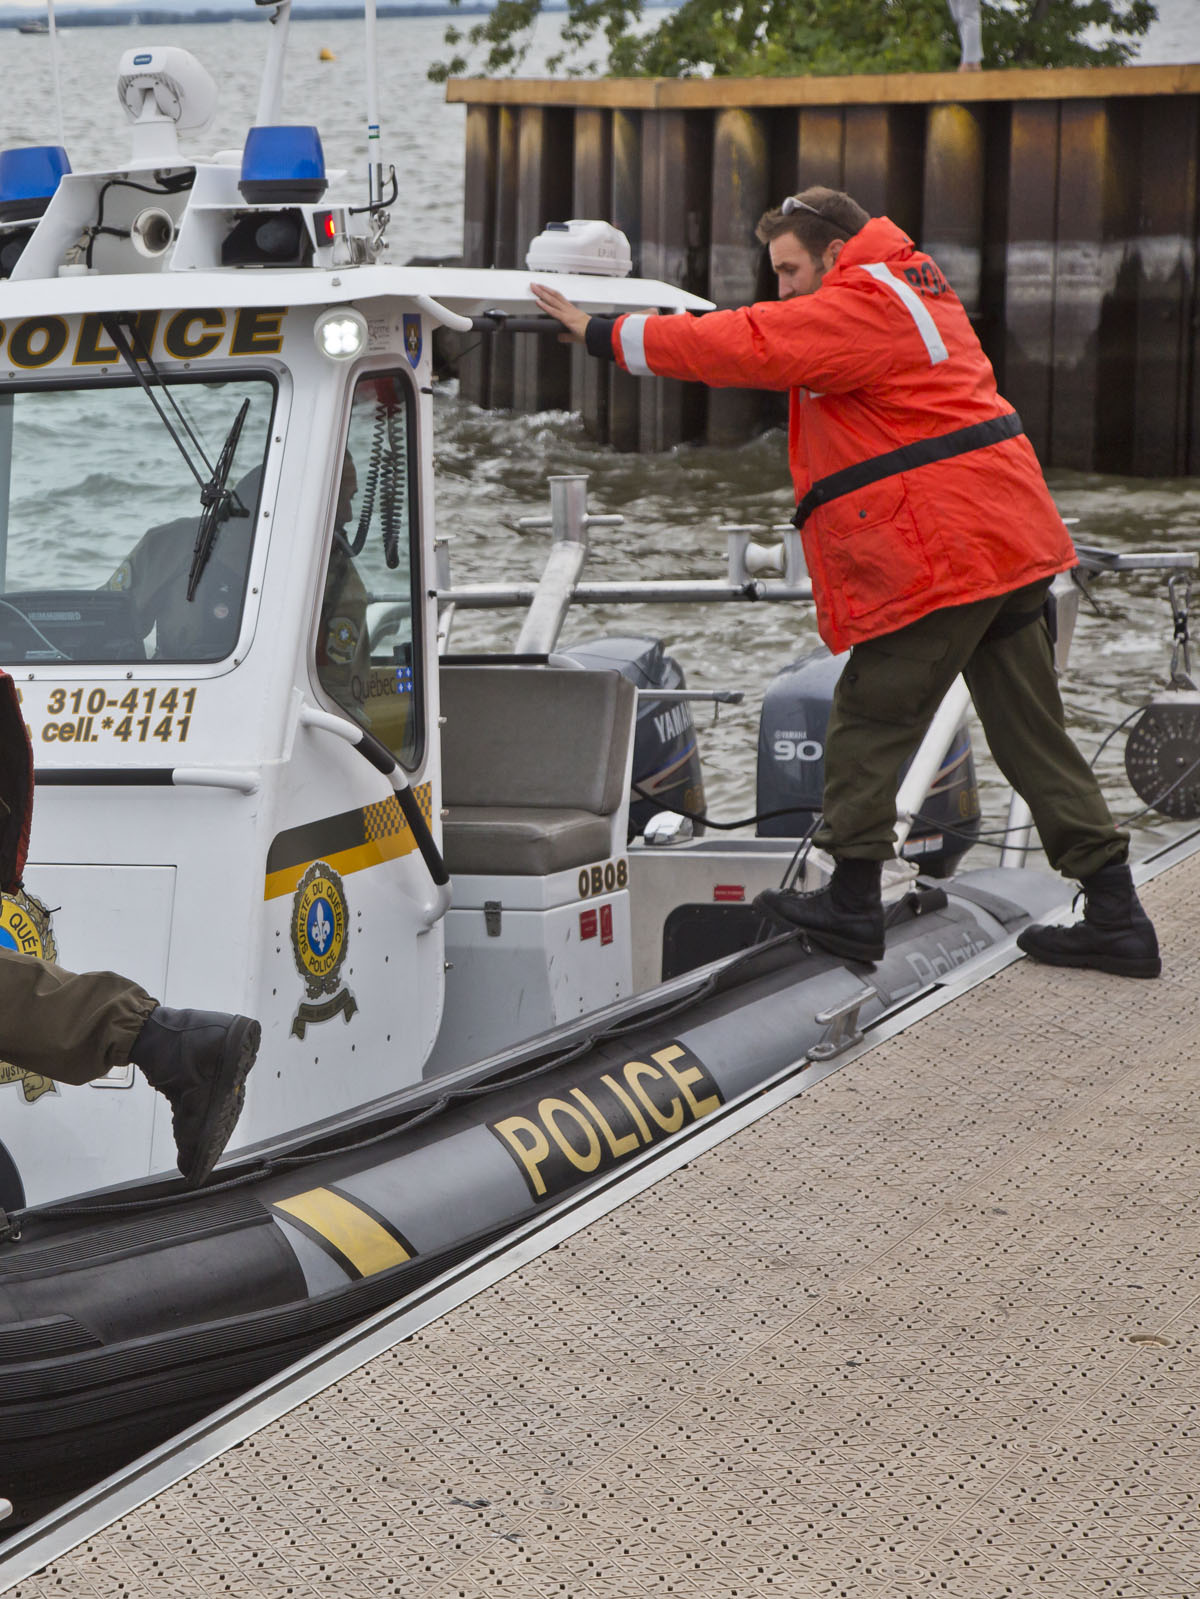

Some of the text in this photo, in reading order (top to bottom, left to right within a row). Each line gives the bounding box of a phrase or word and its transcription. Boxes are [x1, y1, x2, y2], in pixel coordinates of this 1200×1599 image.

[352, 671, 397, 705] Québec
[47, 687, 197, 715] 310-4141
[653, 701, 690, 744] YAMA
[774, 740, 823, 761] 90
[312, 881, 324, 897] DU
[308, 950, 337, 973] POLICE
[0, 1064, 25, 1080] JUST
[494, 1044, 721, 1197] POLICE
